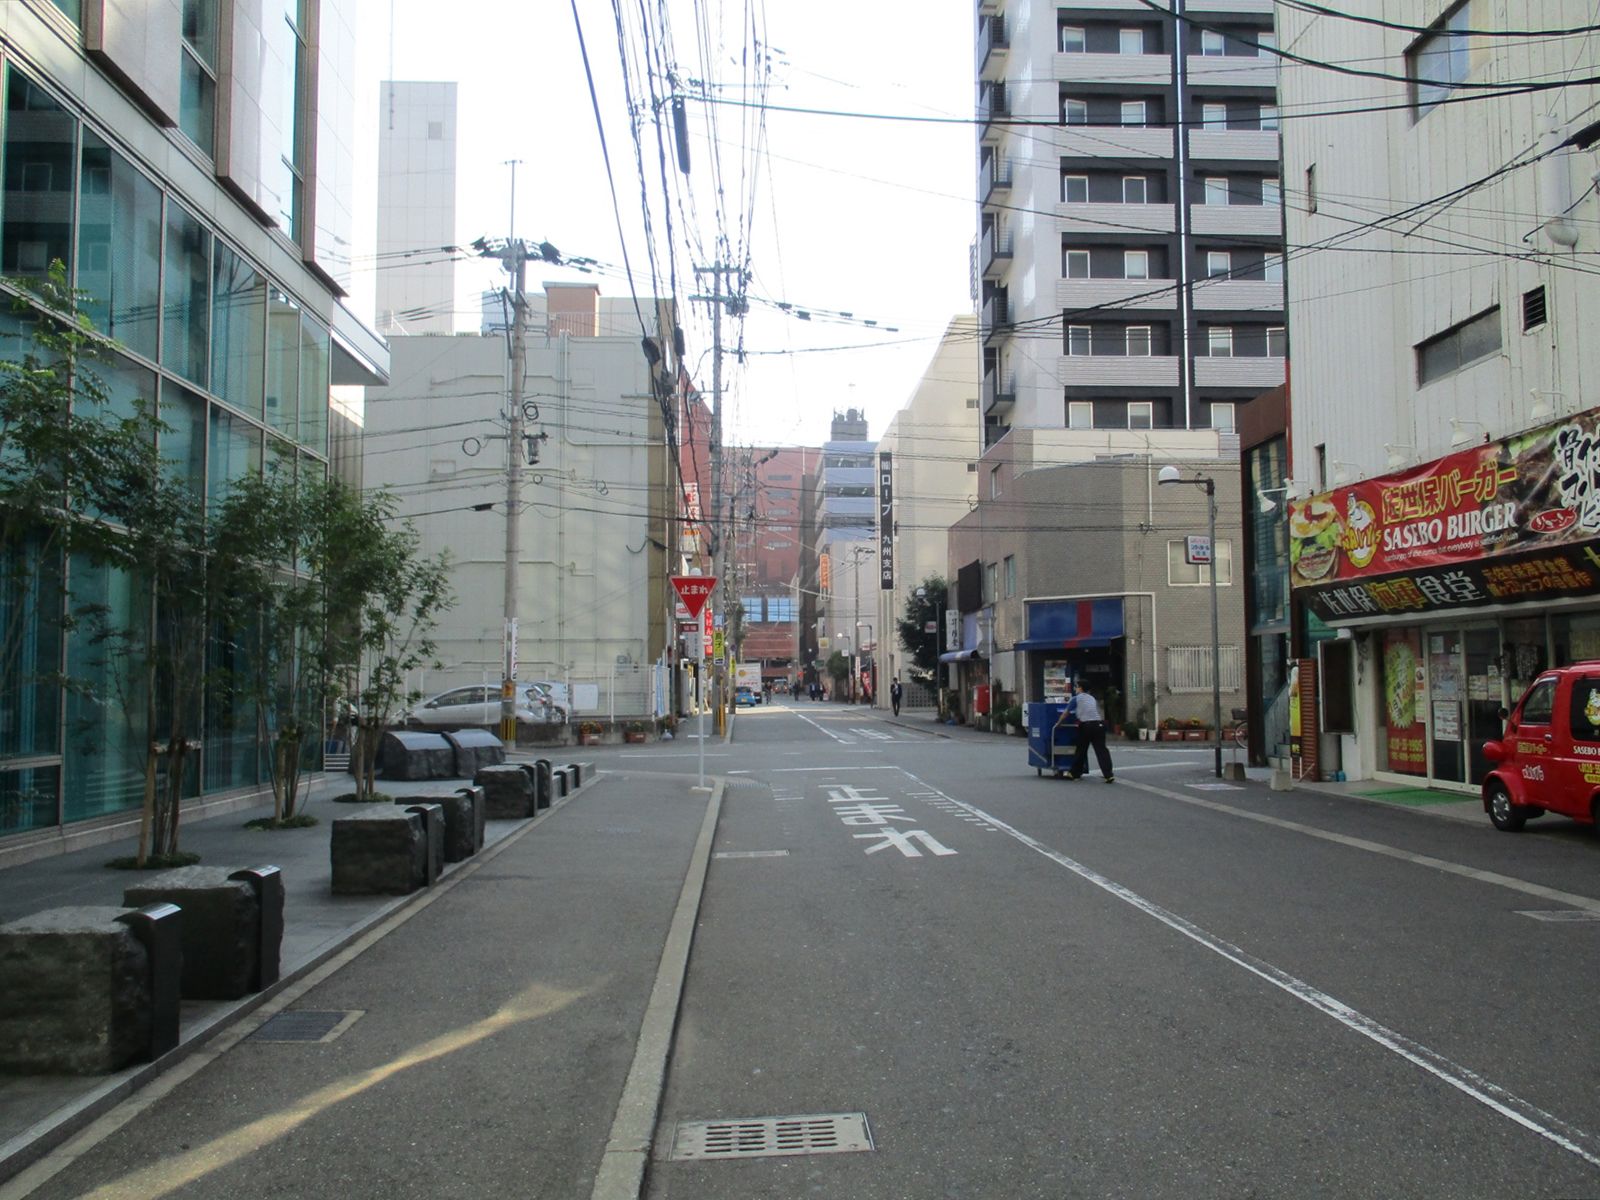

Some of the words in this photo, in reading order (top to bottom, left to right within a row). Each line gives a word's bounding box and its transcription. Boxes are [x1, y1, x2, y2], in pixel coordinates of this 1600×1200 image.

[1382, 459, 1519, 525] 佐世保バーガー
[1383, 518, 1443, 552] SASEBO
[1447, 502, 1518, 541] BURGER
[882, 535, 892, 580] 九州支店
[681, 585, 708, 595] 止まれ
[1318, 571, 1486, 615] 佐世保海軍食堂
[1573, 745, 1597, 756] SASEBO
[818, 784, 958, 857] 止まれ
